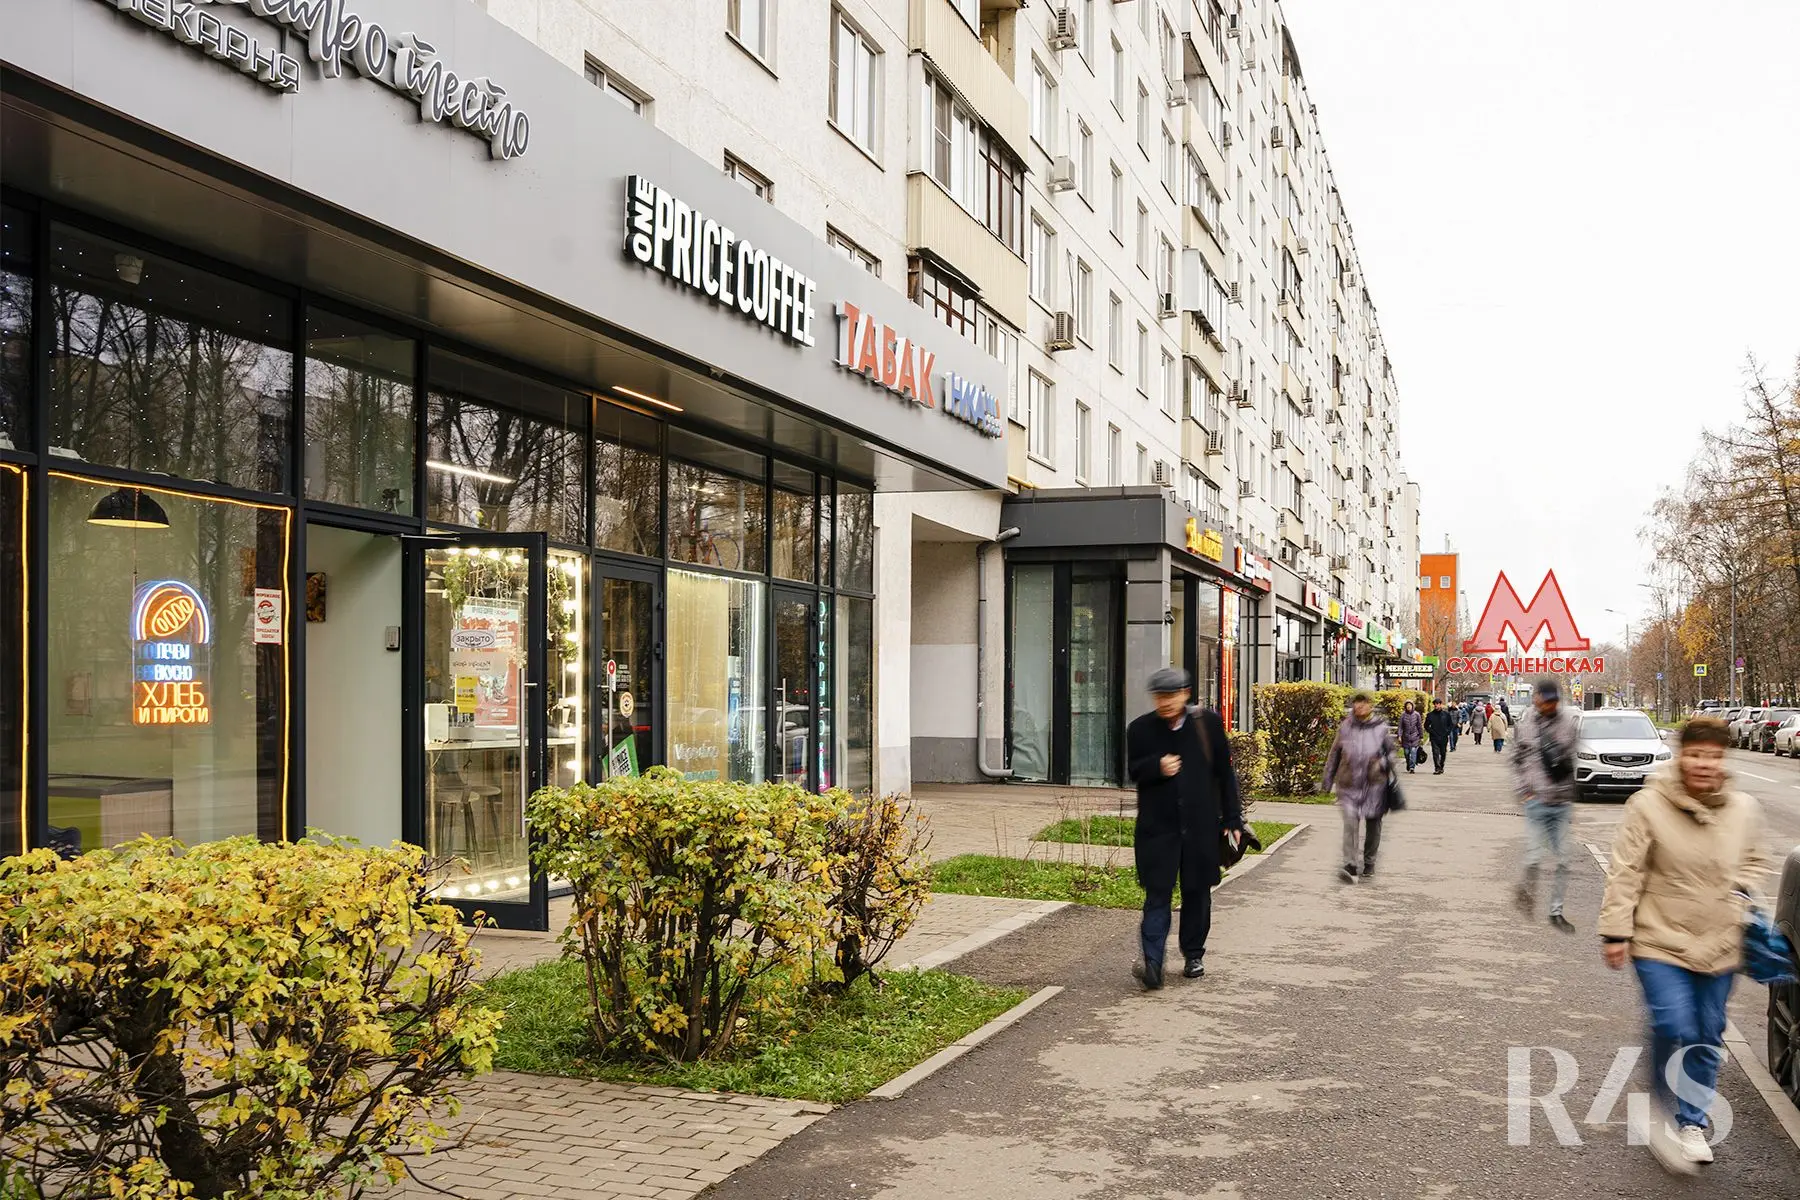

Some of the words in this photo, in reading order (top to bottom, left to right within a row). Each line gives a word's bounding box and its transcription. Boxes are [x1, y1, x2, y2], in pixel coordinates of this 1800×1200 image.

[118, 0, 300, 93] ЕКАРНЯ
[398, 32, 530, 160] тесто
[625, 174, 654, 263] ONE
[653, 186, 734, 307] PRICE
[732, 239, 816, 348] COFFEE
[835, 301, 935, 410] ТАБАК
[455, 634, 491, 646] закрыто
[138, 707, 150, 723] И
[153, 707, 208, 723] ПИРОГИ
[142, 682, 205, 707] ХЛЕБ
